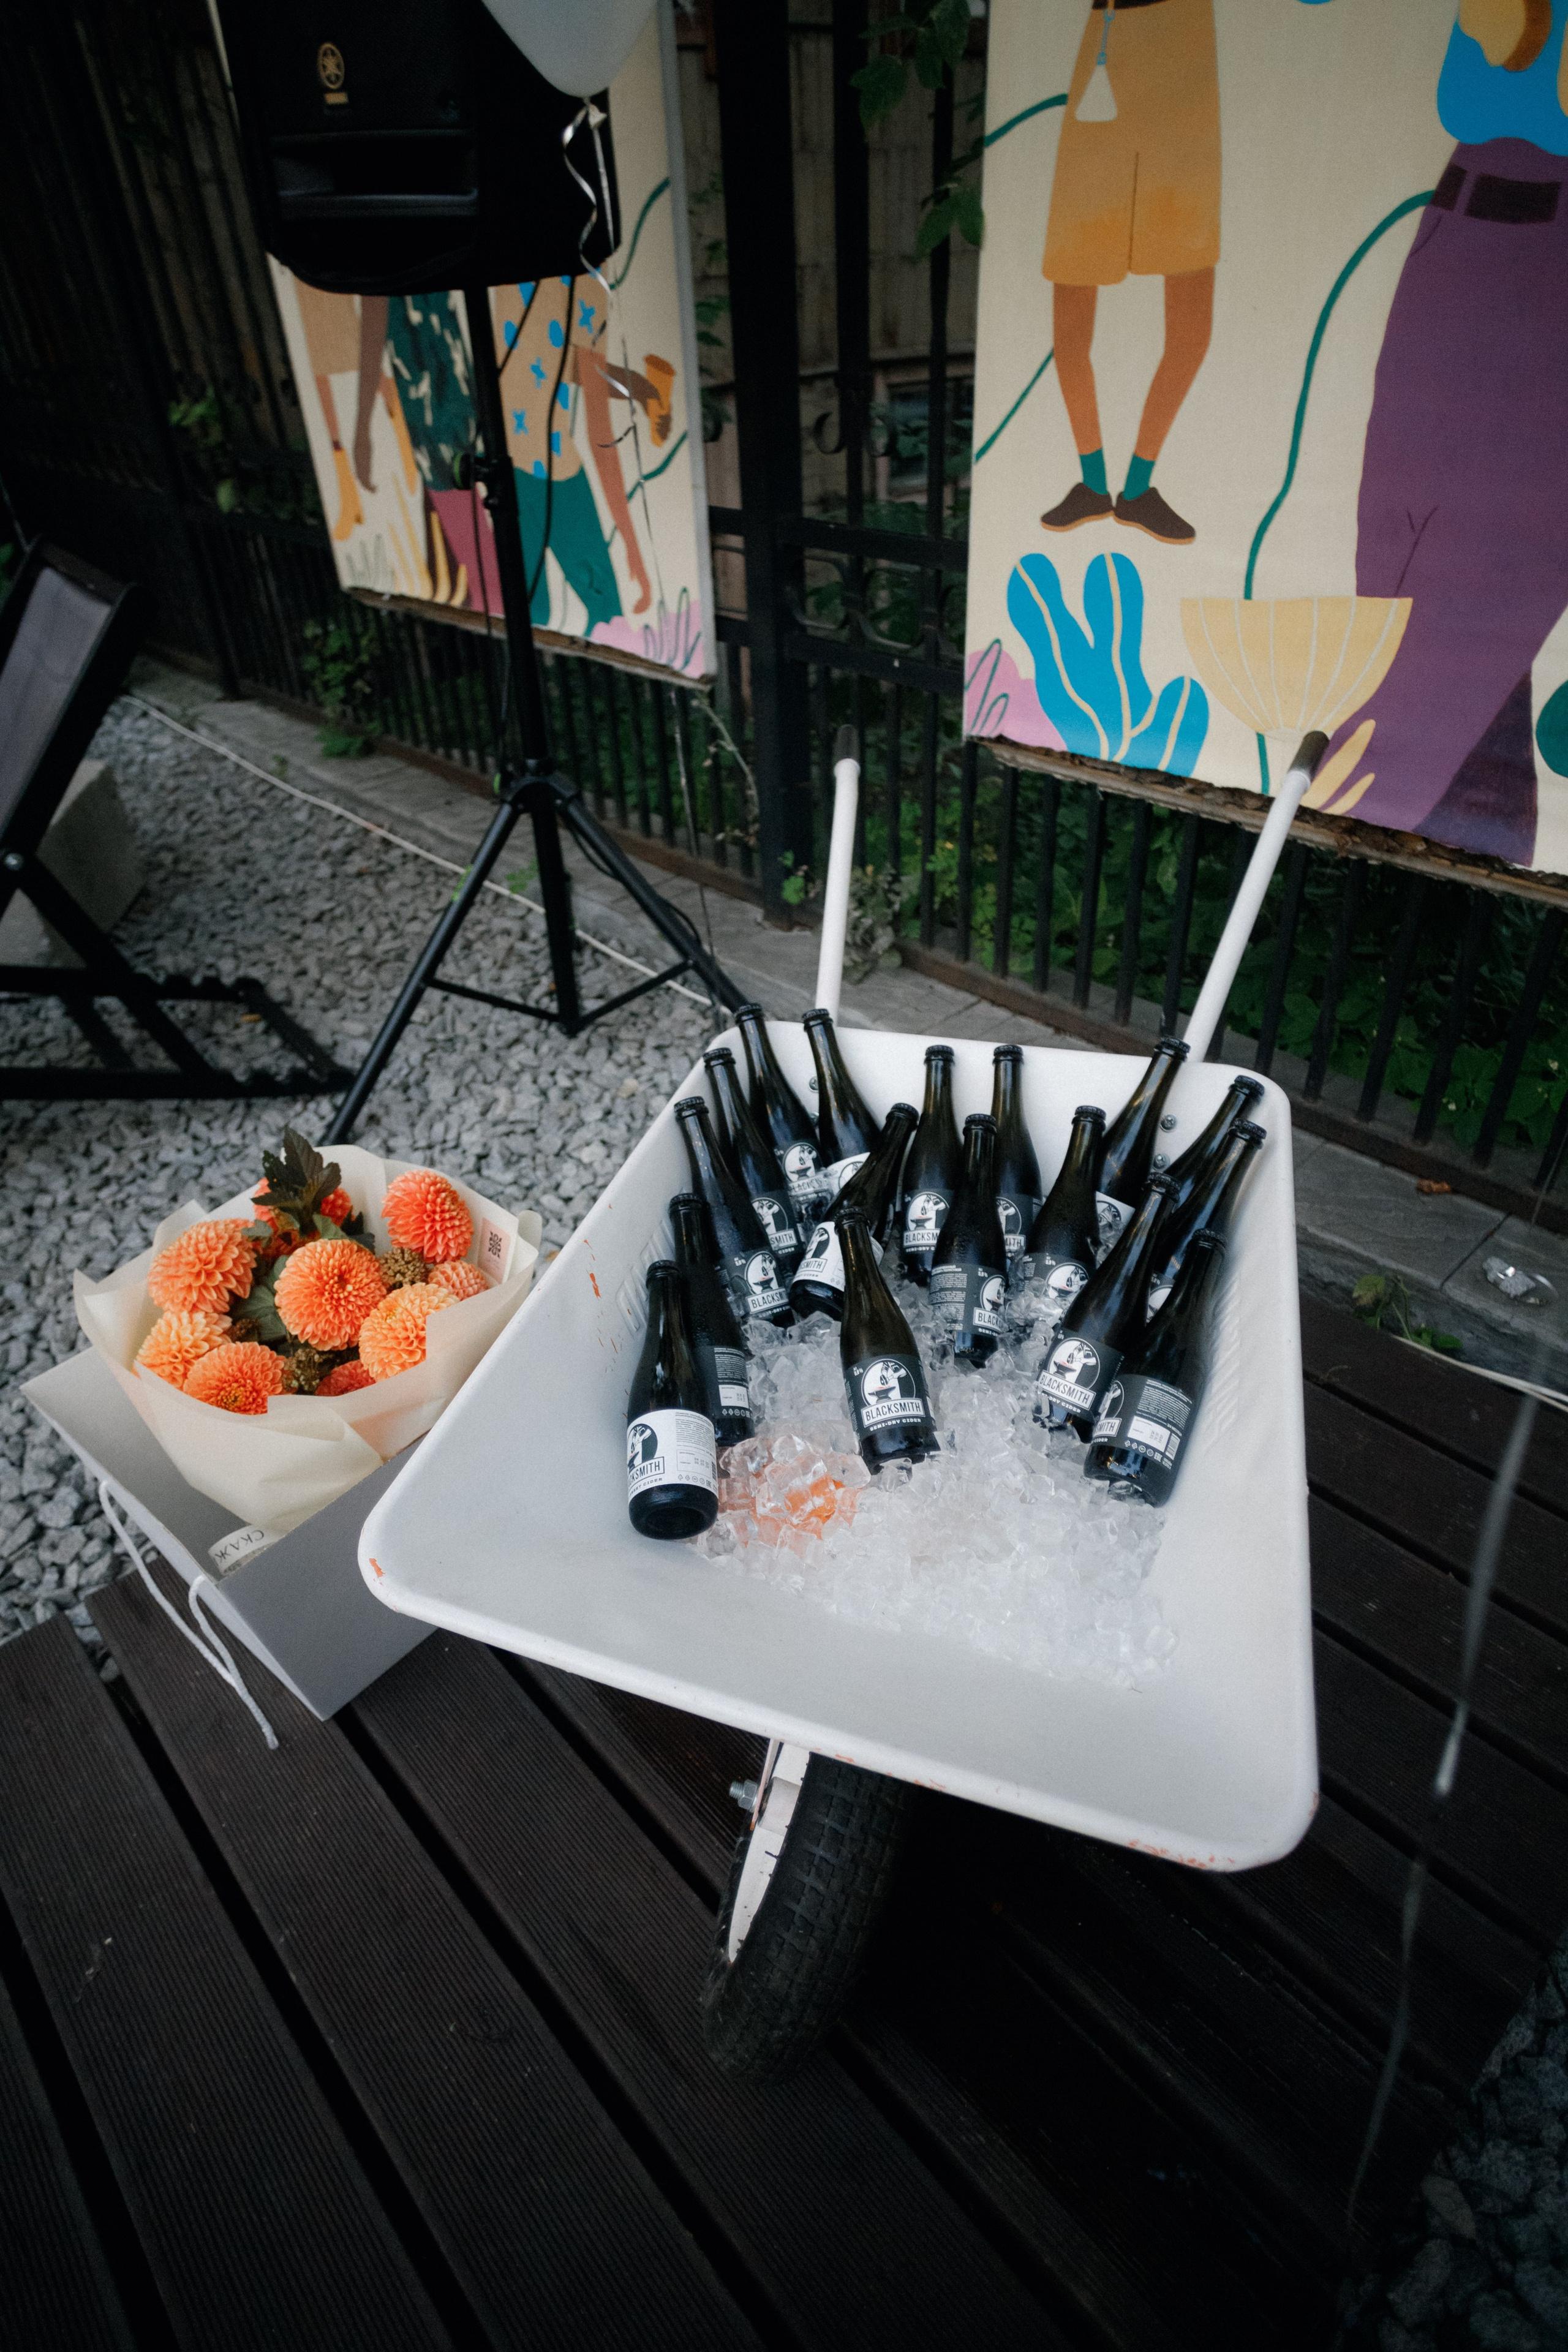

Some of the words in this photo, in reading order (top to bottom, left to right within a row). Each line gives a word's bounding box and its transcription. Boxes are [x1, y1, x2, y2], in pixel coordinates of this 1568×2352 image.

[770, 1233, 794, 1245] SMITH
[1039, 1374, 1090, 1404] BLACKSMITH
[865, 1402, 921, 1422] BLACKSMITH
[1061, 1402, 1081, 1413] CIDER
[870, 1419, 900, 1431] SEMI-DRY
[643, 1477, 663, 1486] CIDER
